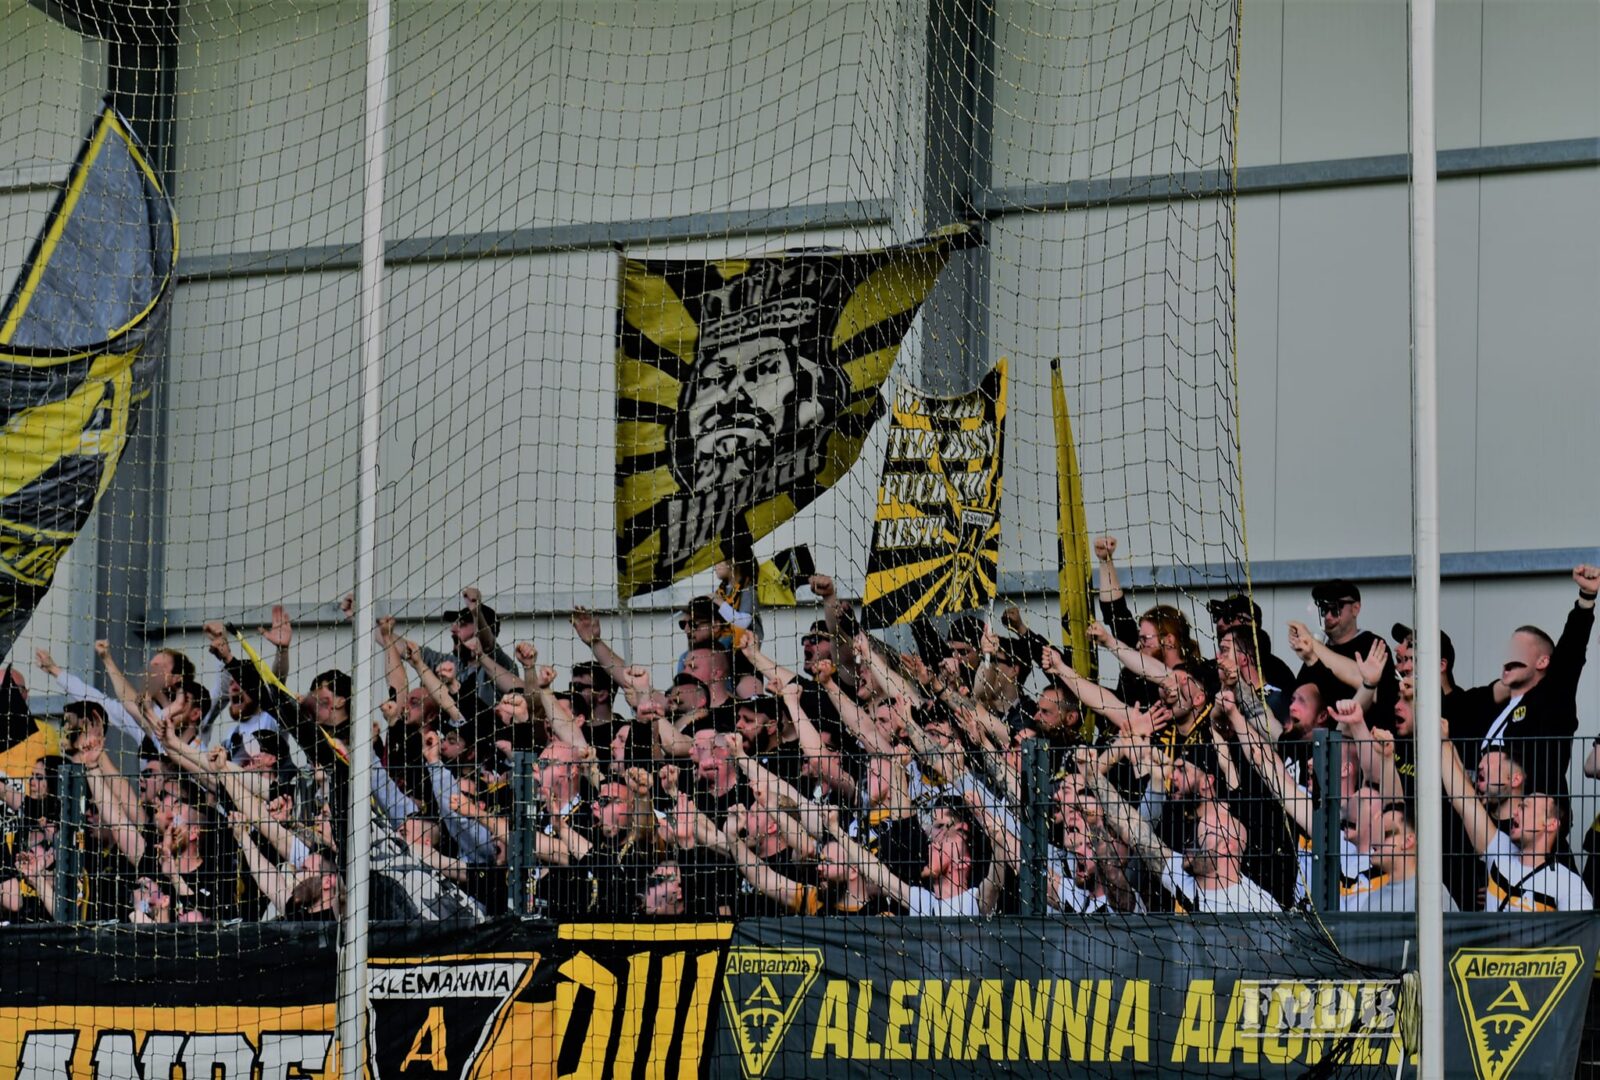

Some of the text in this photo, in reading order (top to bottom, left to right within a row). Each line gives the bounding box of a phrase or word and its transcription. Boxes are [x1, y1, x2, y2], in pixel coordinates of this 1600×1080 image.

[725, 954, 811, 973] Alemannia
[1464, 956, 1568, 977] Alemannia
[369, 969, 511, 993] ALEMANNIA
[1486, 980, 1530, 1011] A
[811, 979, 1150, 1062] ALEMANNIA
